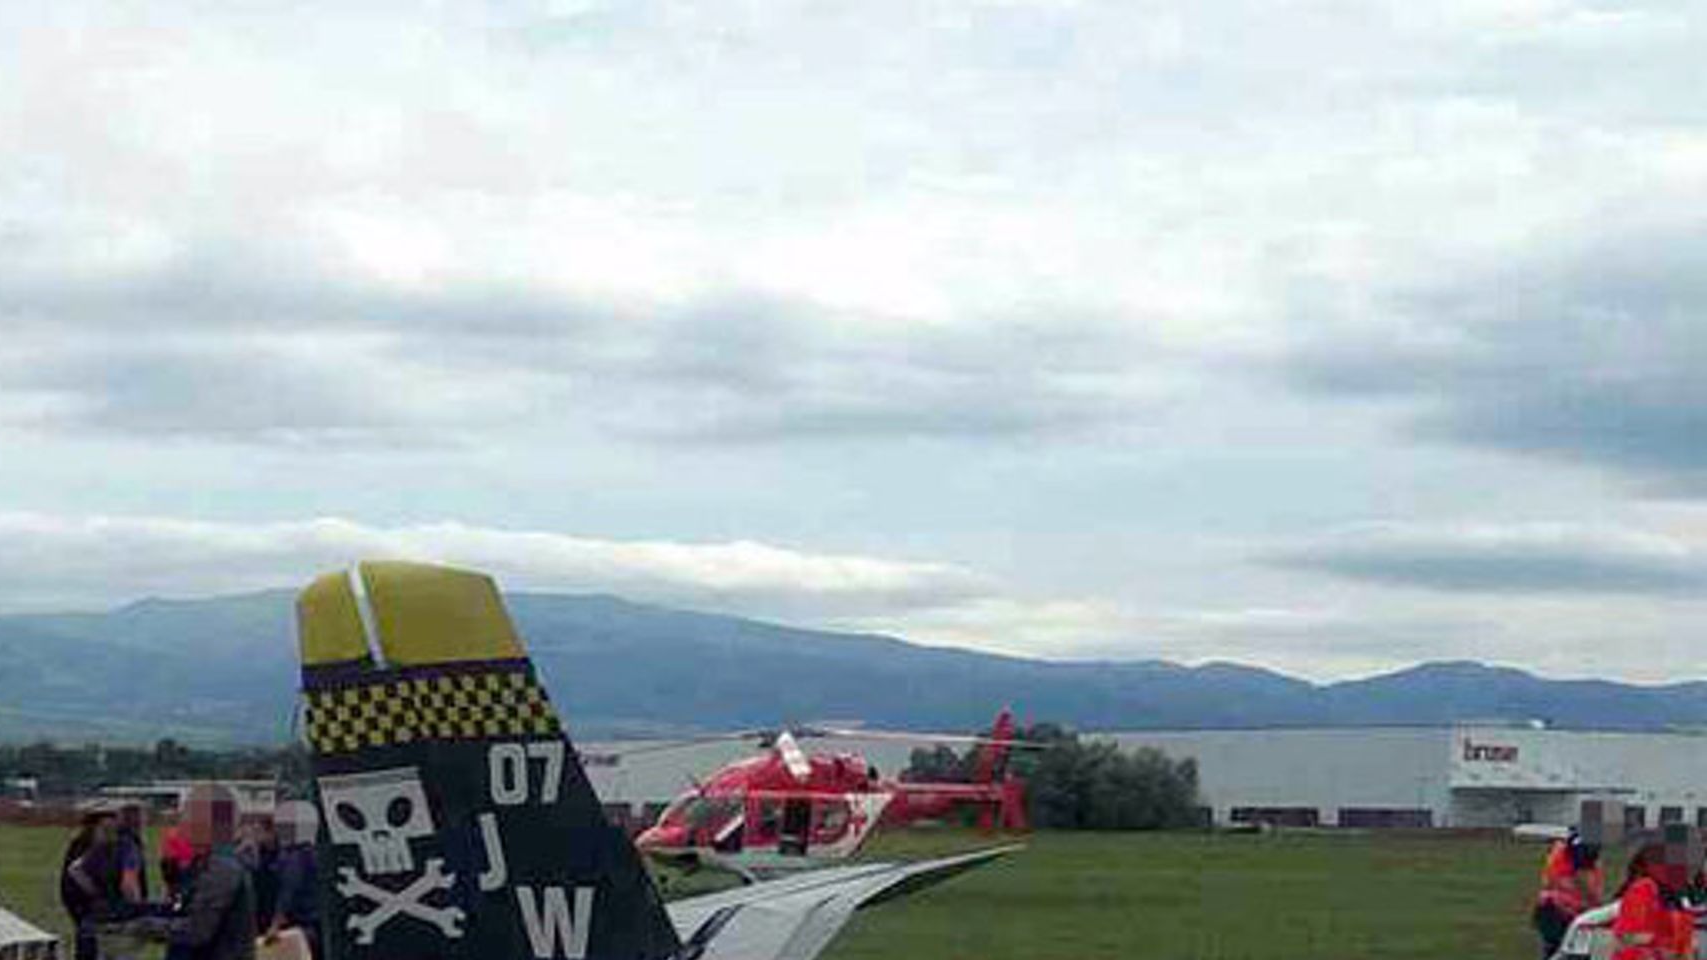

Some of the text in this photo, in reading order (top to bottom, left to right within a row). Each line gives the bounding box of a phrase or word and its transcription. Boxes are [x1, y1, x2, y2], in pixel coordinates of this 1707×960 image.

[490, 741, 564, 805] 07
[478, 813, 507, 891] J
[516, 886, 593, 960] W
